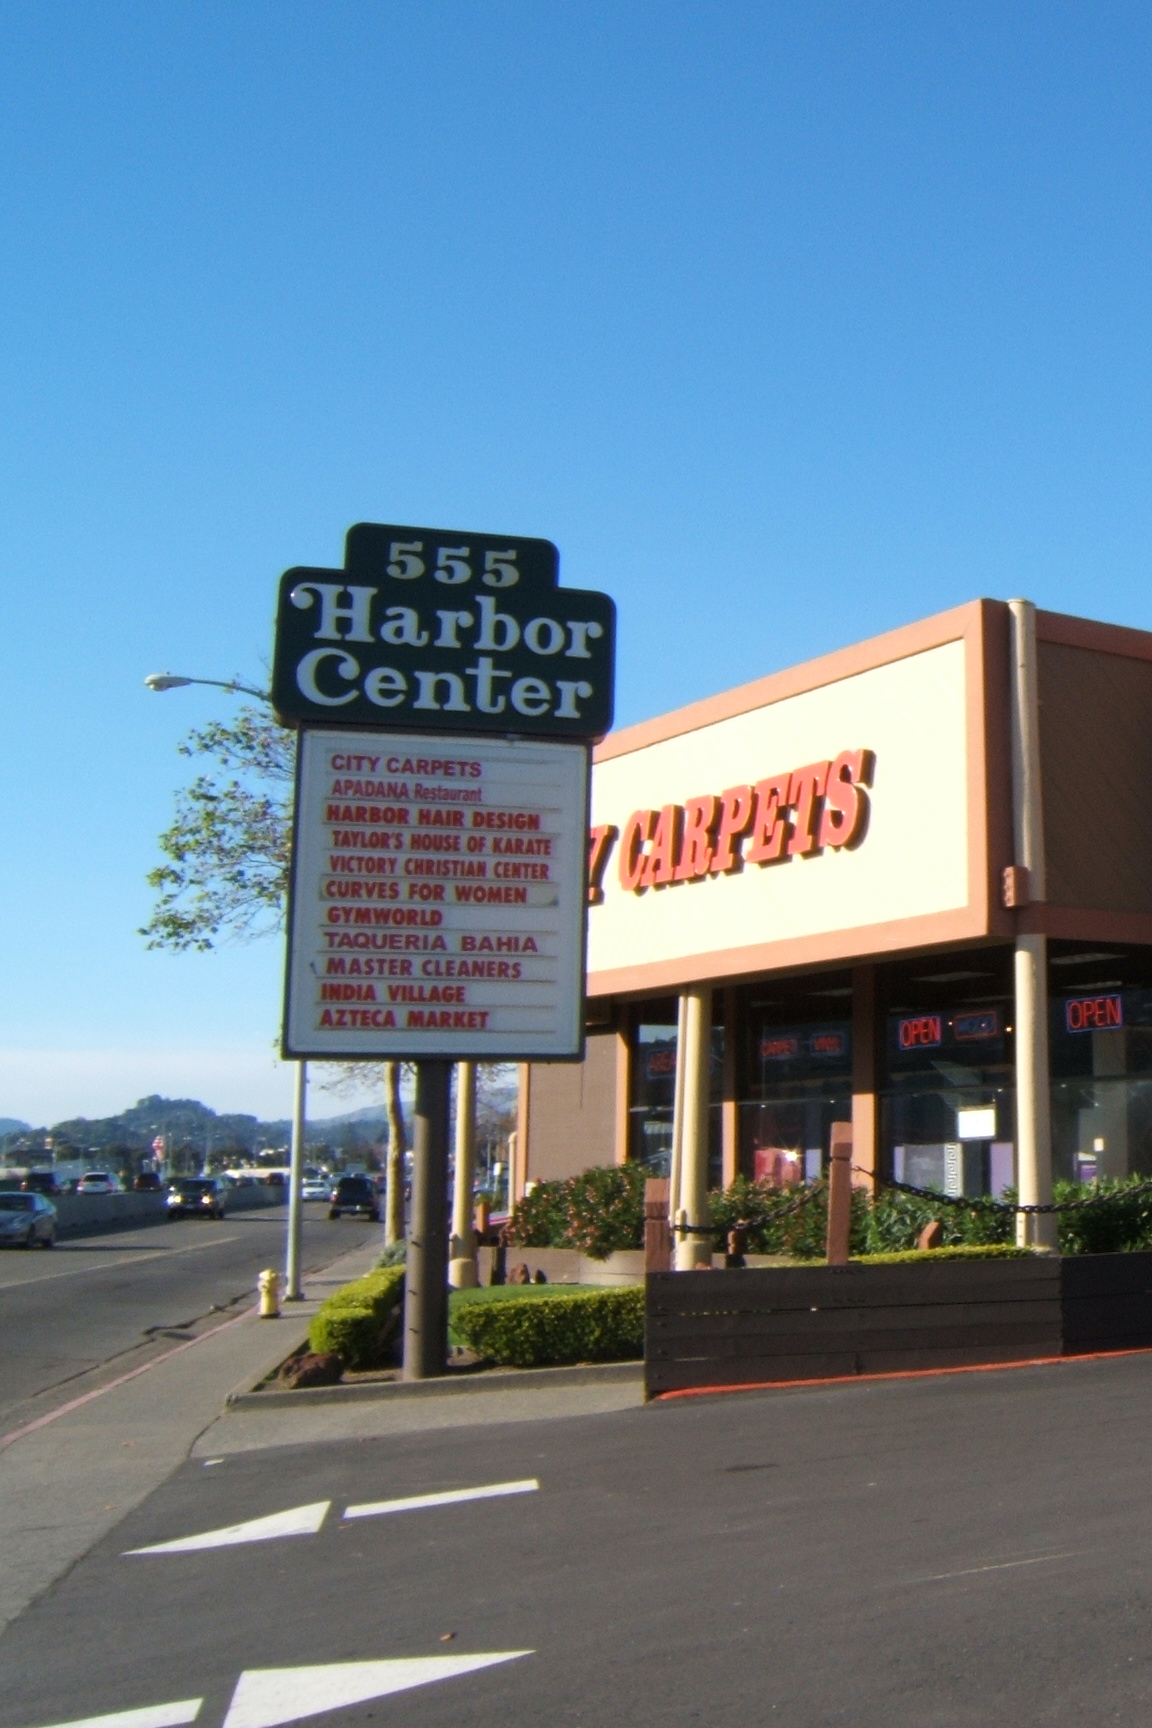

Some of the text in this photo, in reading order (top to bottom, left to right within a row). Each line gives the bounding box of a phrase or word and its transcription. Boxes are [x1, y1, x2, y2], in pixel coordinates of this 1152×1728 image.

[386, 541, 520, 588] 555
[290, 582, 603, 658] Harbor
[296, 647, 593, 718] Center
[331, 754, 482, 778] CITY CARPETS
[332, 779, 482, 802] APADANA Restaurant
[326, 805, 540, 830] HARBOR HAIR DESIGN
[618, 748, 876, 897] CARPETS
[333, 830, 552, 856] TAYLOR'S HOUSE OF KARATE
[330, 855, 550, 880] VICTORY CHRISTIAN CENTER
[326, 880, 527, 904] CURVES FOR WOMEN
[327, 906, 443, 927] GYMWORLD
[324, 932, 538, 952] TAQUERIA BAHIA
[326, 957, 522, 979] MASTER CLEANERS
[321, 983, 466, 1003] INDIA VILLAGE
[320, 1008, 489, 1028] AZTECA MARKET
[1068, 999, 1121, 1029] OPEN
[901, 1017, 940, 1047] OPEN
